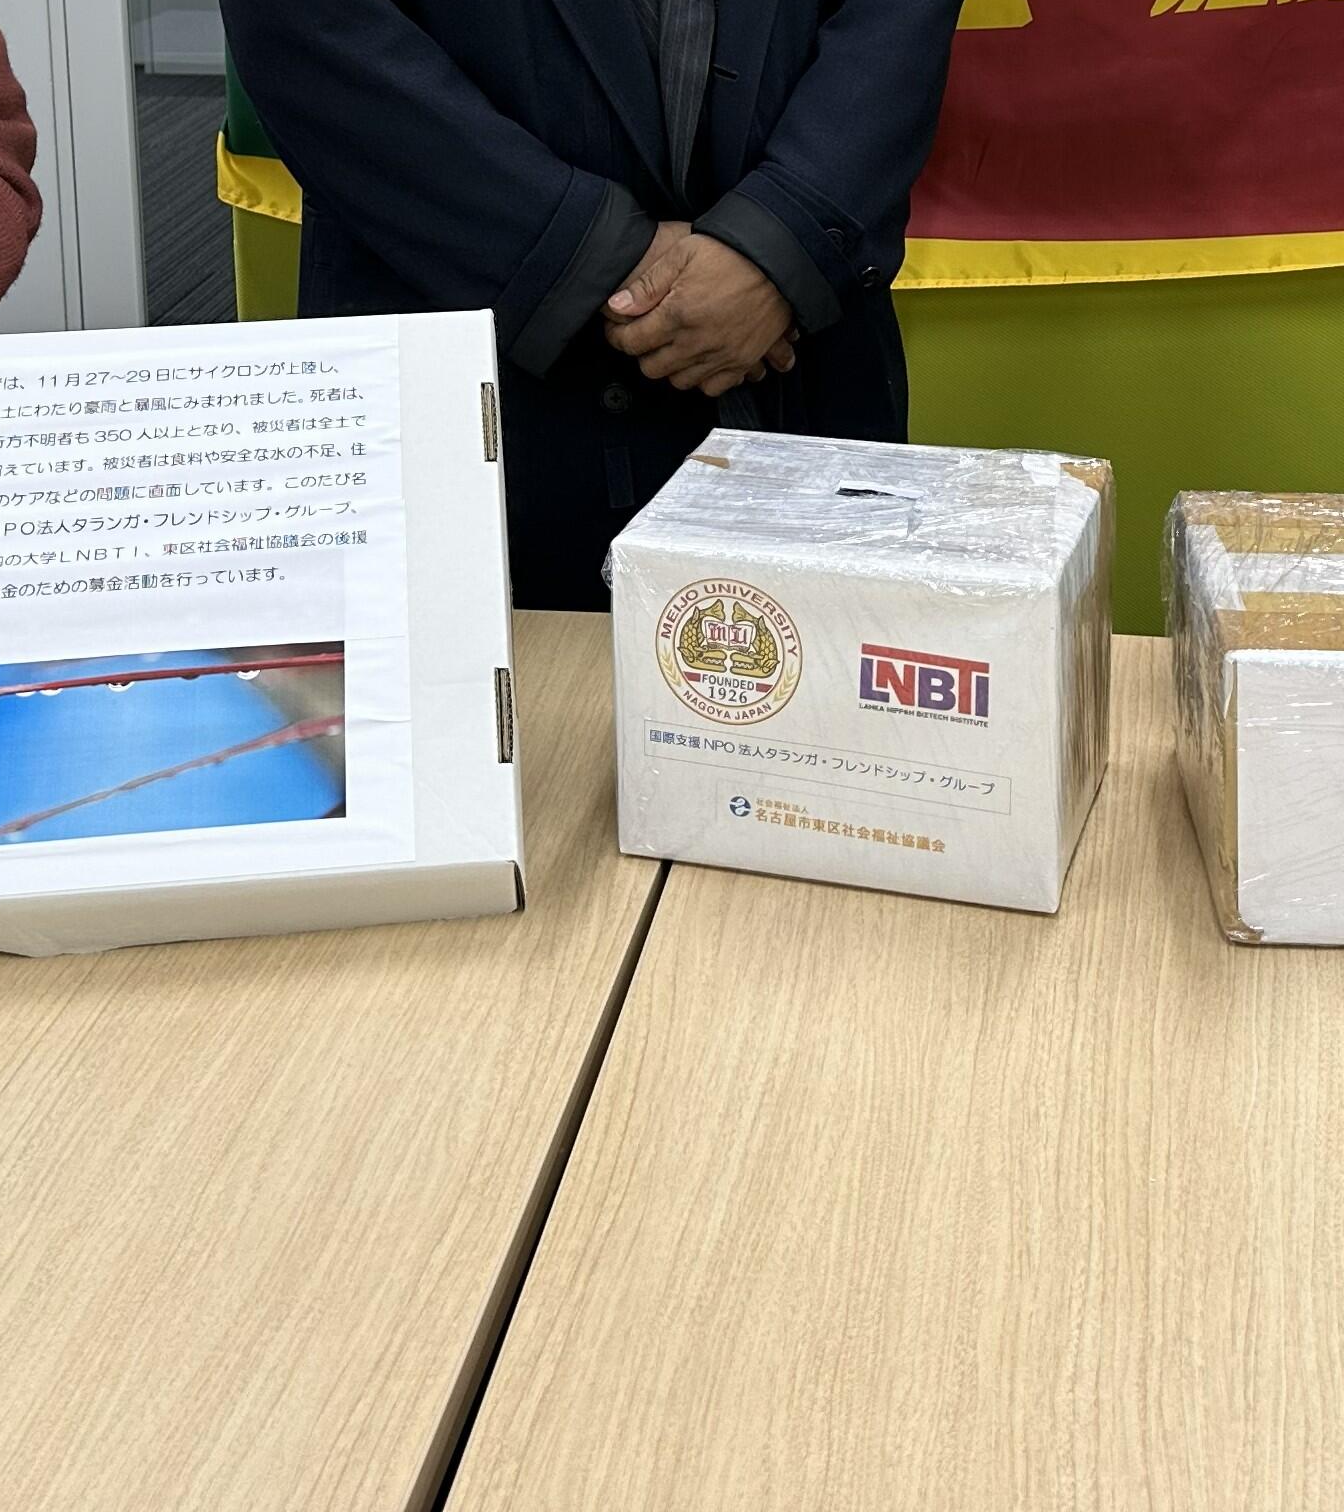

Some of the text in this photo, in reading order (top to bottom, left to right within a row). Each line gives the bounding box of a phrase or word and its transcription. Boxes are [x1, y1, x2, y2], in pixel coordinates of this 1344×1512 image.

[660, 583, 799, 658] MEIJO UNIVERSITY
[701, 673, 755, 691] FOUNDED
[708, 686, 748, 704] 1926
[859, 642, 990, 719] LNBTI
[682, 690, 773, 721] NAGOYA JAPAN
[754, 808, 947, 854] 名古屋市東区社会福祉協議会
